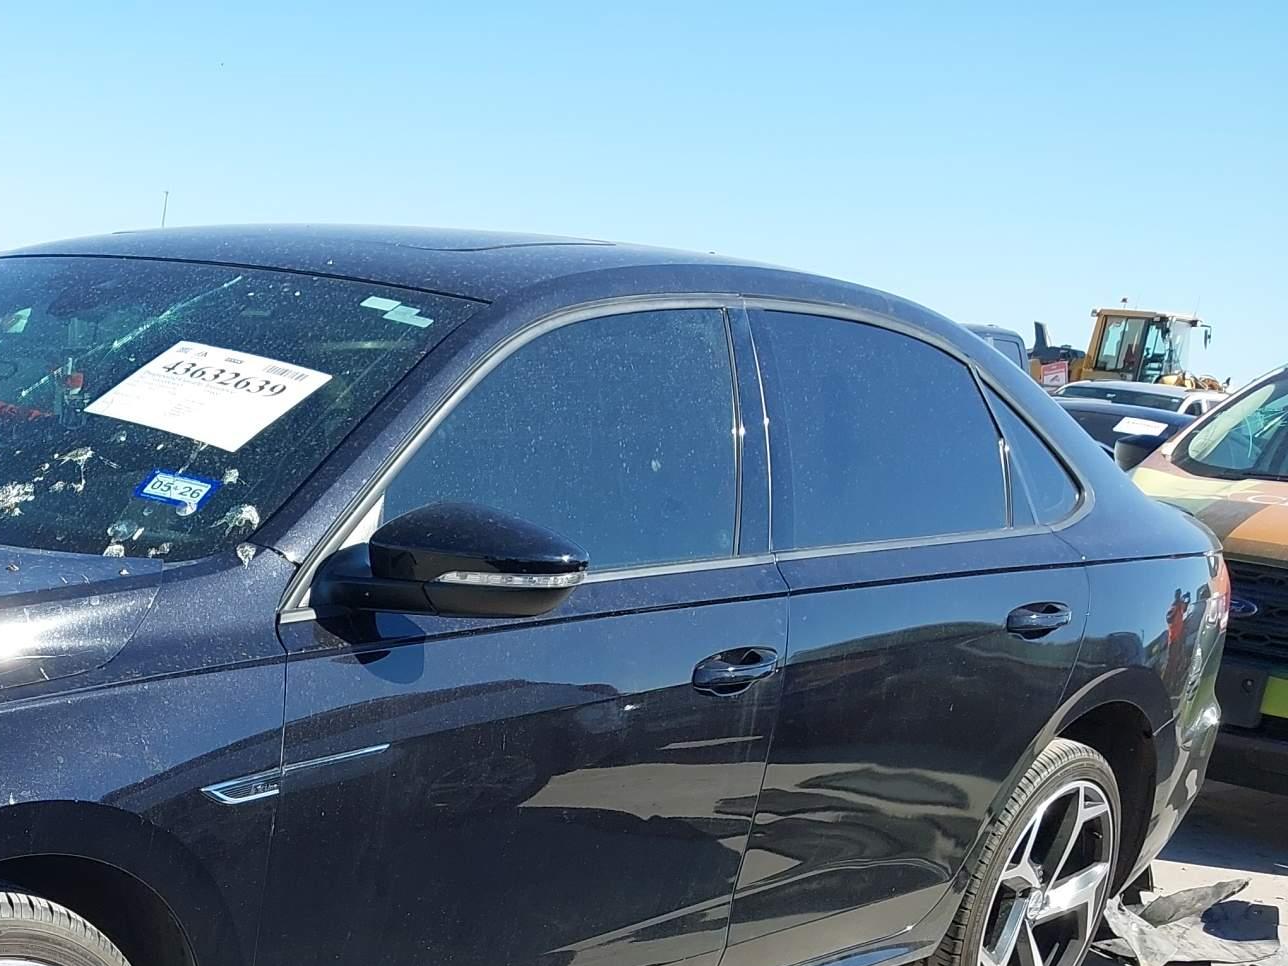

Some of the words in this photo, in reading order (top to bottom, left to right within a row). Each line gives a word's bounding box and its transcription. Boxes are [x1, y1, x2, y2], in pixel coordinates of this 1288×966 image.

[162, 360, 287, 397] 43632639
[151, 480, 173, 492] 05
[179, 486, 203, 498] 26
